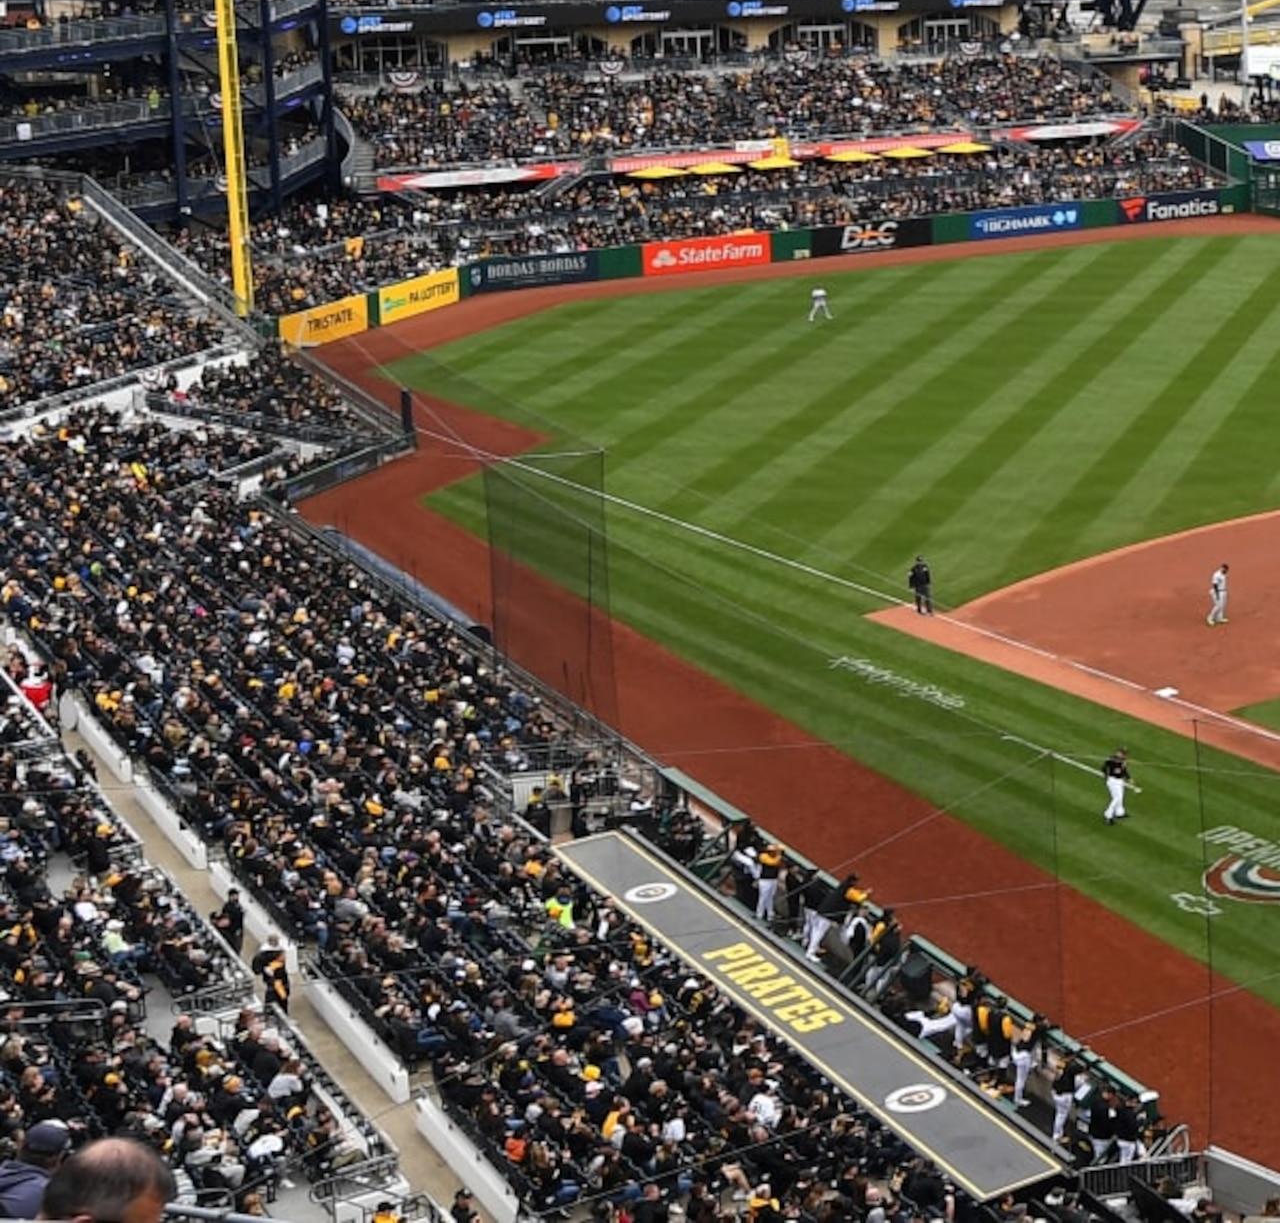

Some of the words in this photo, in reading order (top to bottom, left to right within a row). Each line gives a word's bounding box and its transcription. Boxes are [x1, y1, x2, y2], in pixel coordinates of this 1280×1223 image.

[1147, 198, 1218, 220] Fanatics
[841, 221, 897, 249] DLC
[679, 243, 763, 264] StateFarm
[306, 308, 352, 332] TRISTATE
[701, 941, 849, 1033] PIRATES
